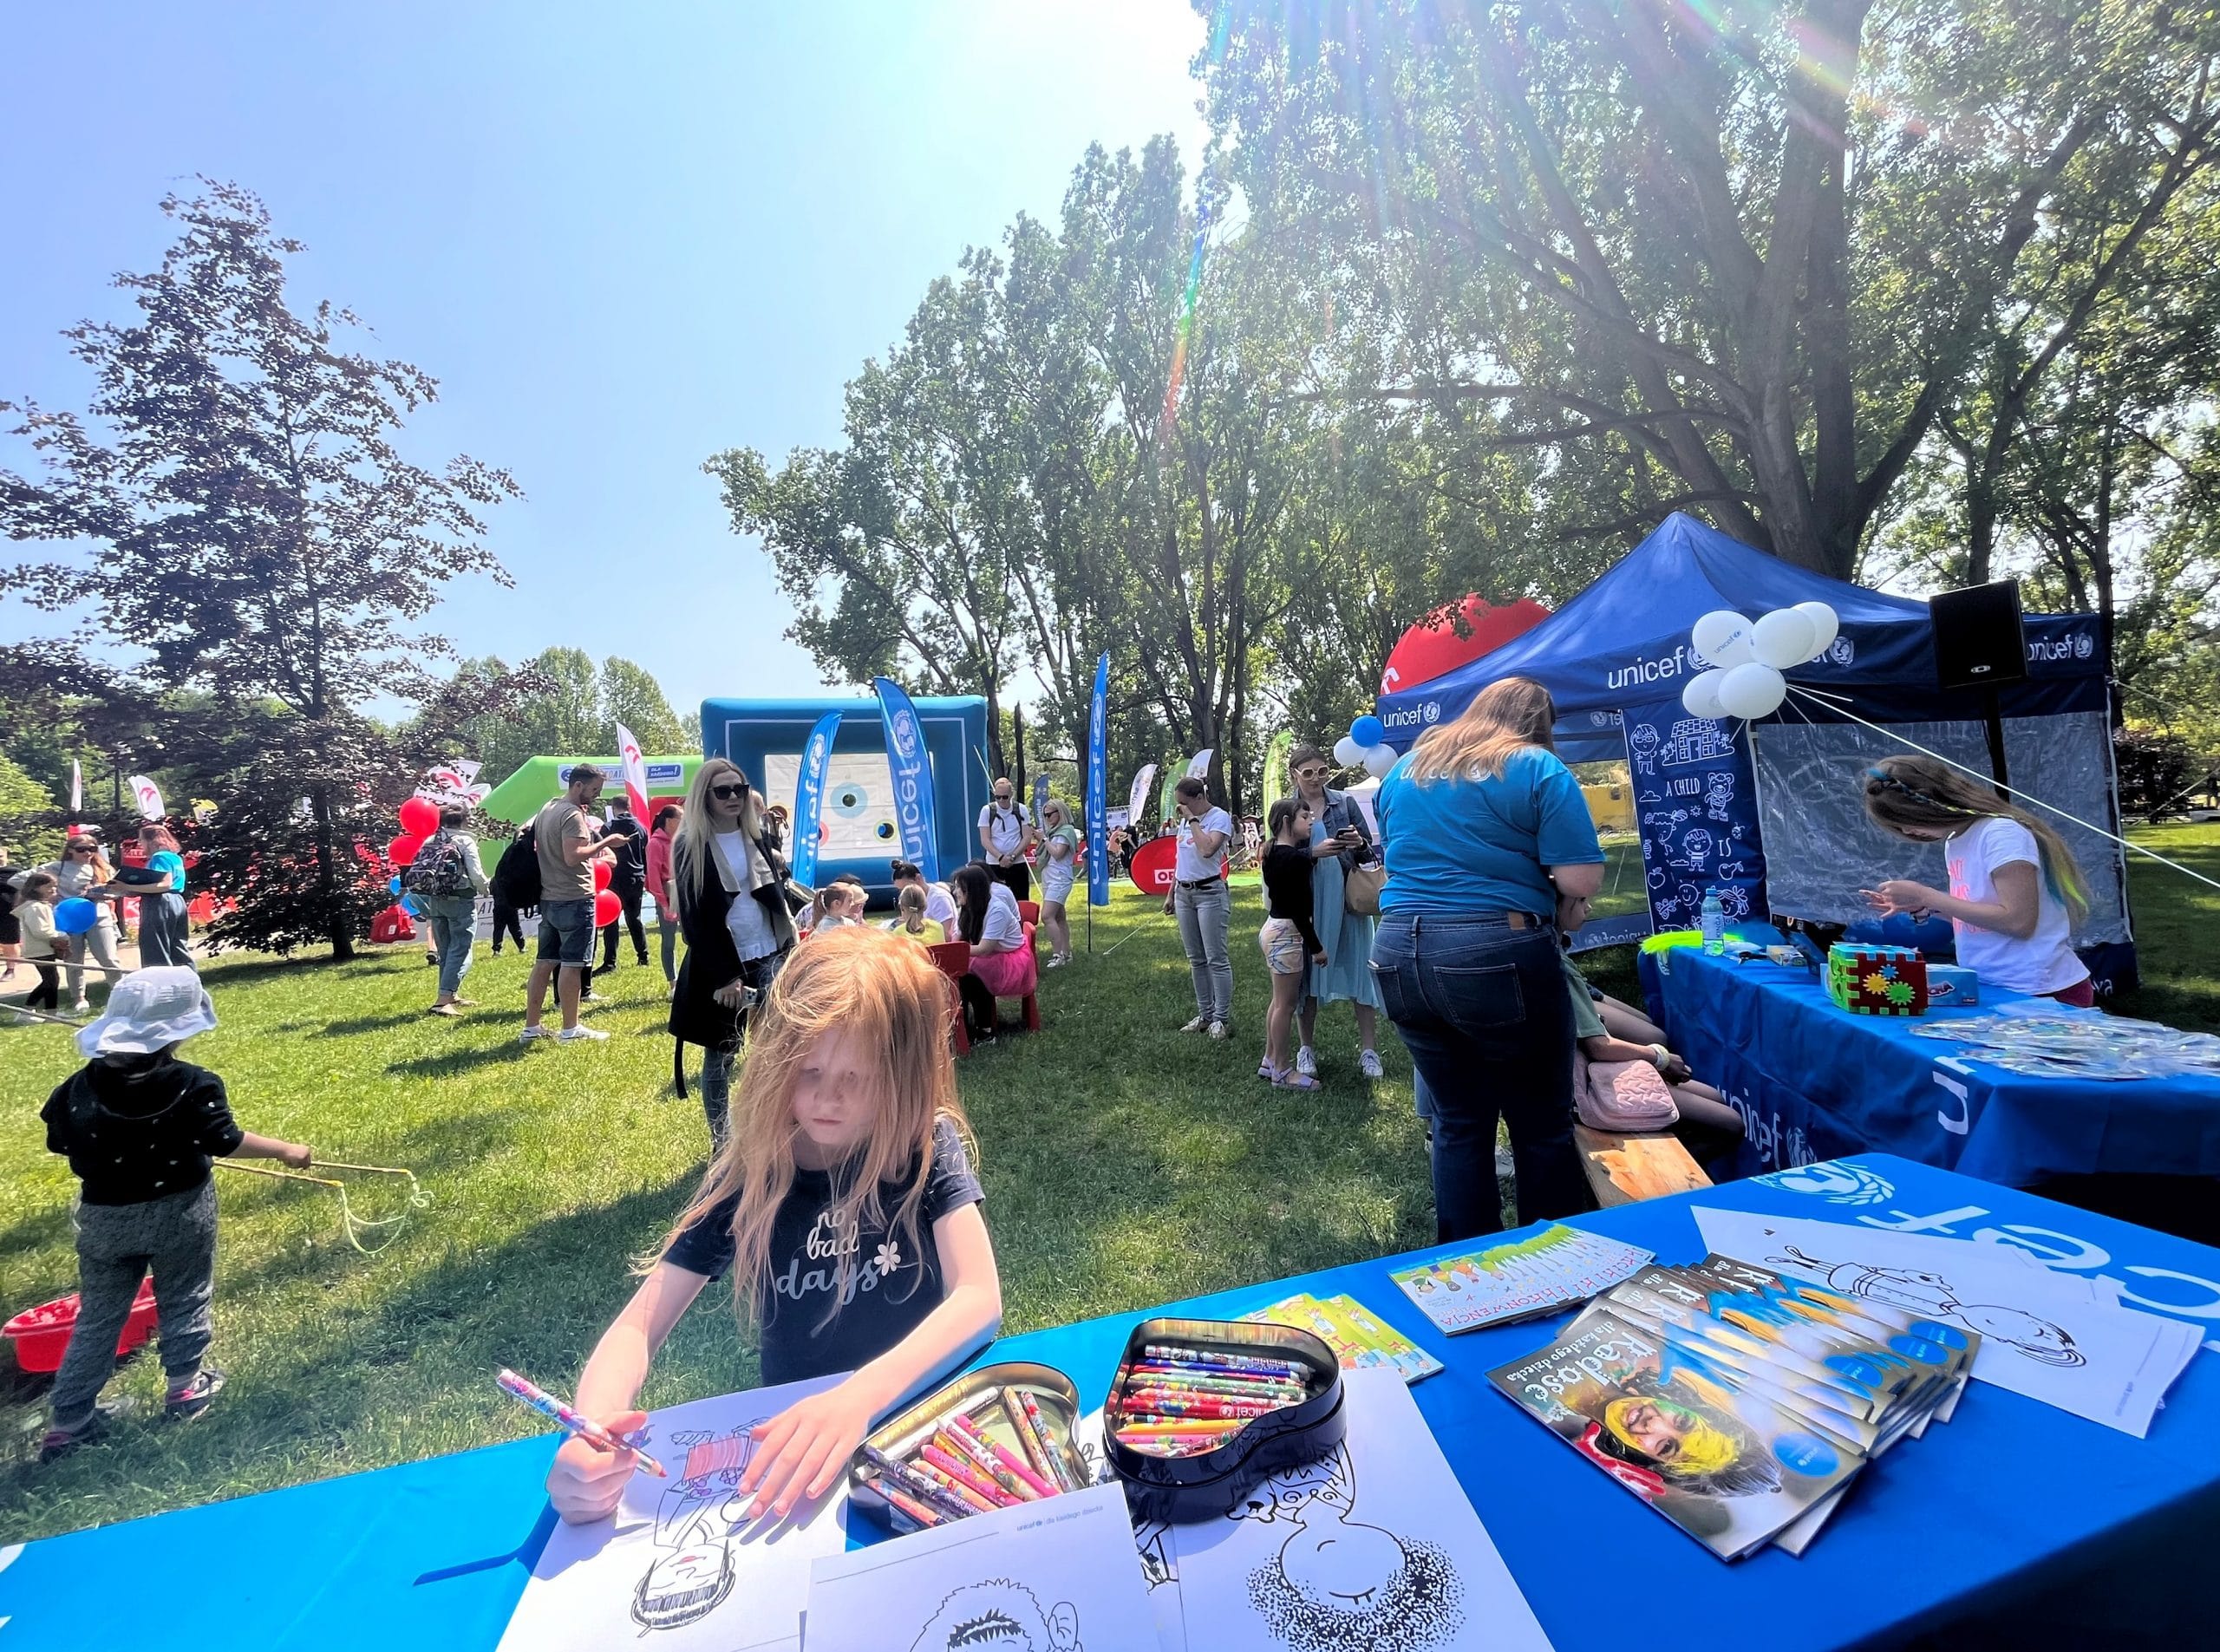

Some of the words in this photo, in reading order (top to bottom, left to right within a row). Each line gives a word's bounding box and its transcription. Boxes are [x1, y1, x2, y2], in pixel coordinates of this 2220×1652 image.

[1608, 645, 1683, 689] unicef
[1384, 702, 1422, 728] unicef
[1665, 781, 1673, 797] A
[1674, 778, 1701, 796] CHILD
[1092, 751, 1102, 885] unicef
[1718, 838, 1731, 857] IS
[817, 1208, 847, 1230] no
[806, 1220, 859, 1260] bad
[775, 1258, 883, 1305] days
[1440, 1291, 1547, 1327] KONWENCJA
[1594, 1320, 1616, 1335] dla
[1551, 1330, 1602, 1361] każdego
[1506, 1359, 1551, 1382] dziecka
